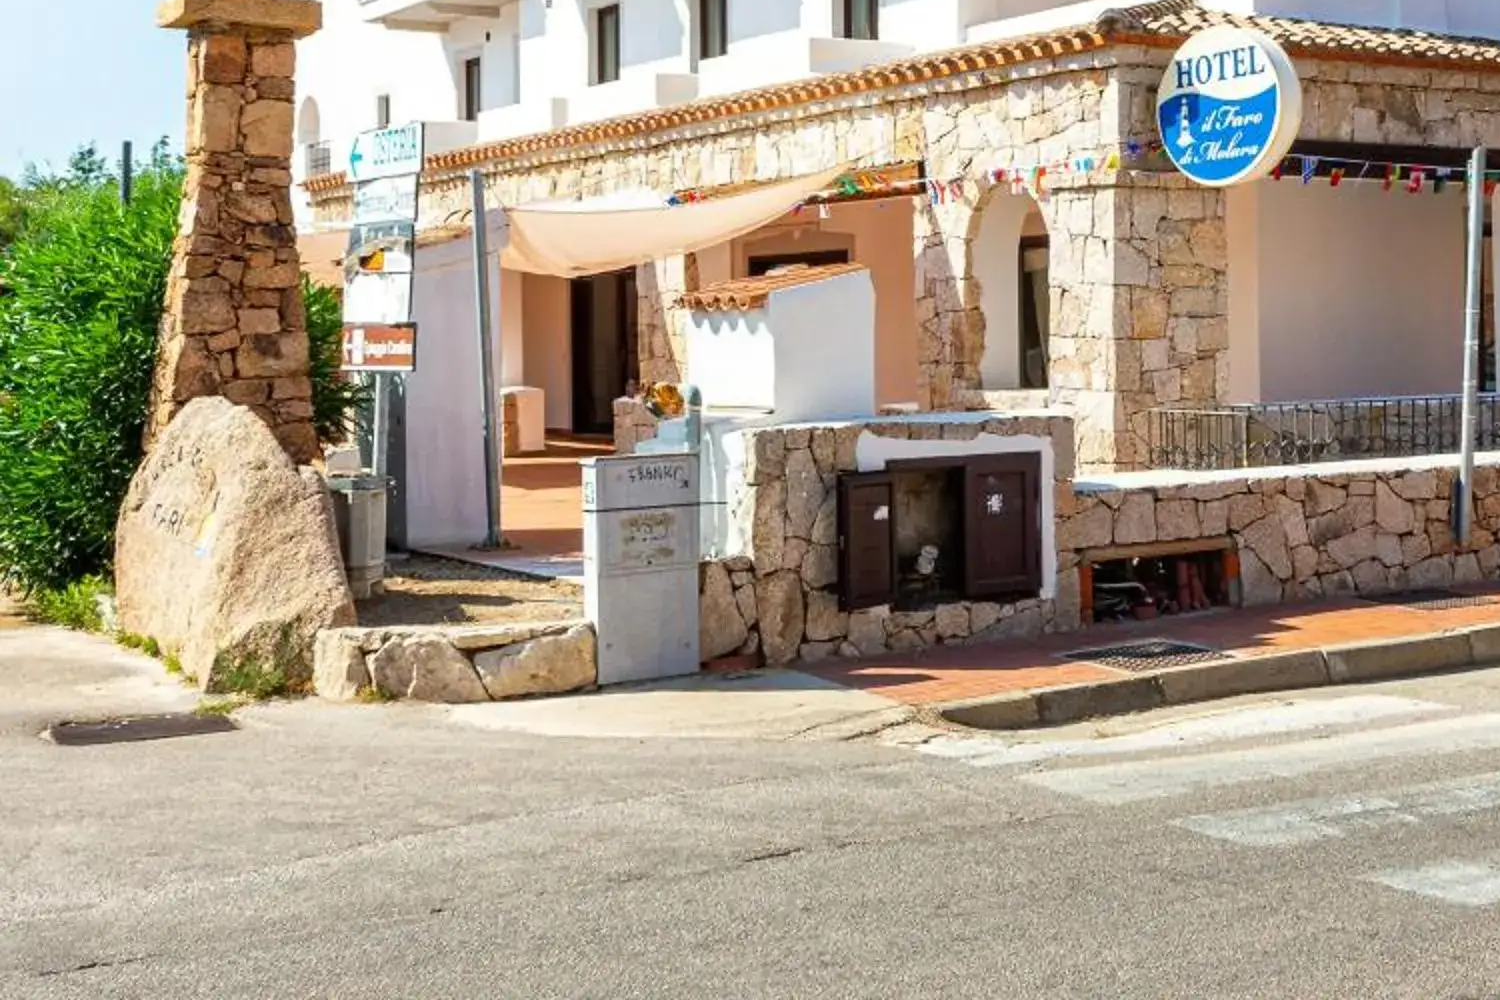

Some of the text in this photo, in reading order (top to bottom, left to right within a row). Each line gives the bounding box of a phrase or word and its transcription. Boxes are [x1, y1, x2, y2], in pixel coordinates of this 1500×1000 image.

[1176, 45, 1265, 88] HOTEL
[1201, 105, 1263, 133] il Faro
[1193, 132, 1260, 163] Molara
